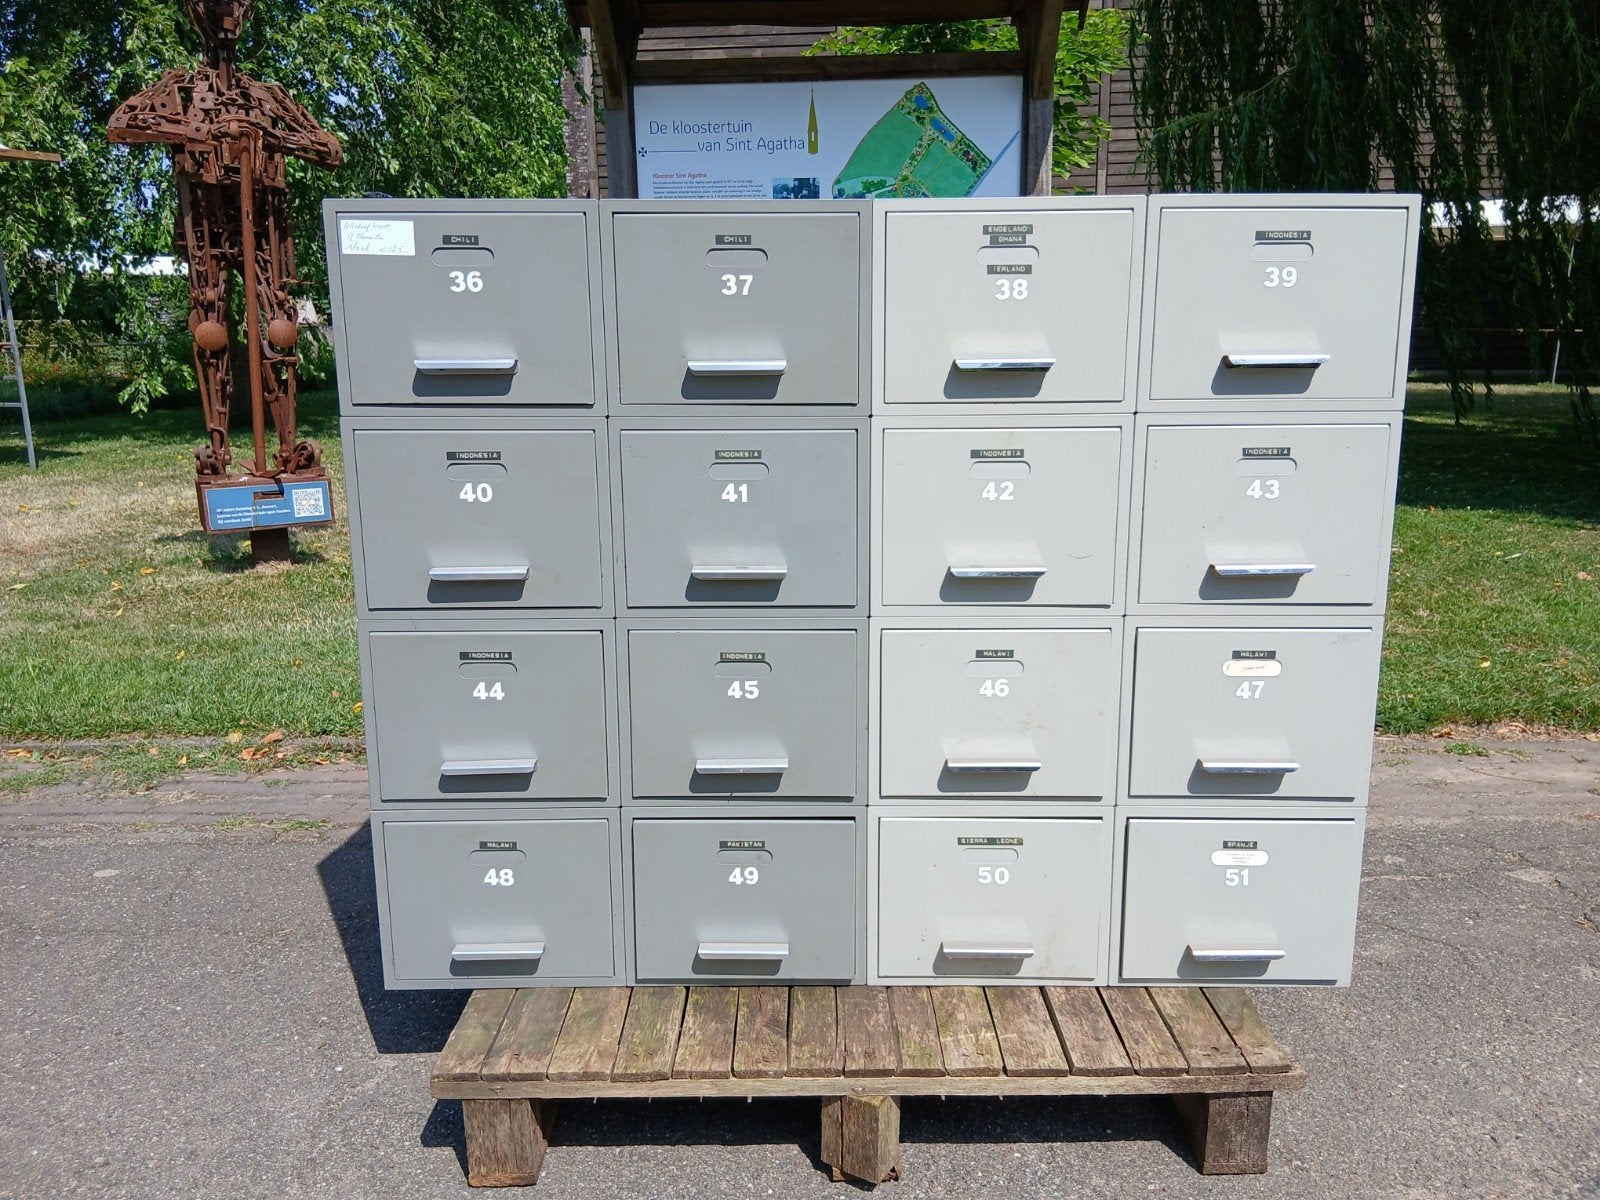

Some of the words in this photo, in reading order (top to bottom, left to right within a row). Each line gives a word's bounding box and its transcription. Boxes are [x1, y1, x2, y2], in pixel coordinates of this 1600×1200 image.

[649, 120, 668, 135] De
[672, 120, 752, 134] kloostertuin
[697, 141, 721, 152] van
[726, 137, 752, 151] Sint
[757, 136, 805, 155] Agatha
[449, 271, 483, 292] 36
[721, 274, 753, 295] 37
[1263, 267, 1297, 288] 39
[994, 279, 1028, 300] 38
[460, 483, 493, 502] 40
[721, 483, 747, 503] 41
[981, 481, 1014, 501] 42
[1246, 480, 1280, 500] 43
[473, 682, 505, 700] 44
[728, 680, 760, 700] 45
[979, 679, 1009, 698] 46
[1235, 680, 1265, 699] 47
[484, 869, 515, 886] 48
[729, 867, 759, 885] 49
[978, 867, 1009, 885] 50
[1225, 868, 1249, 887] 51
